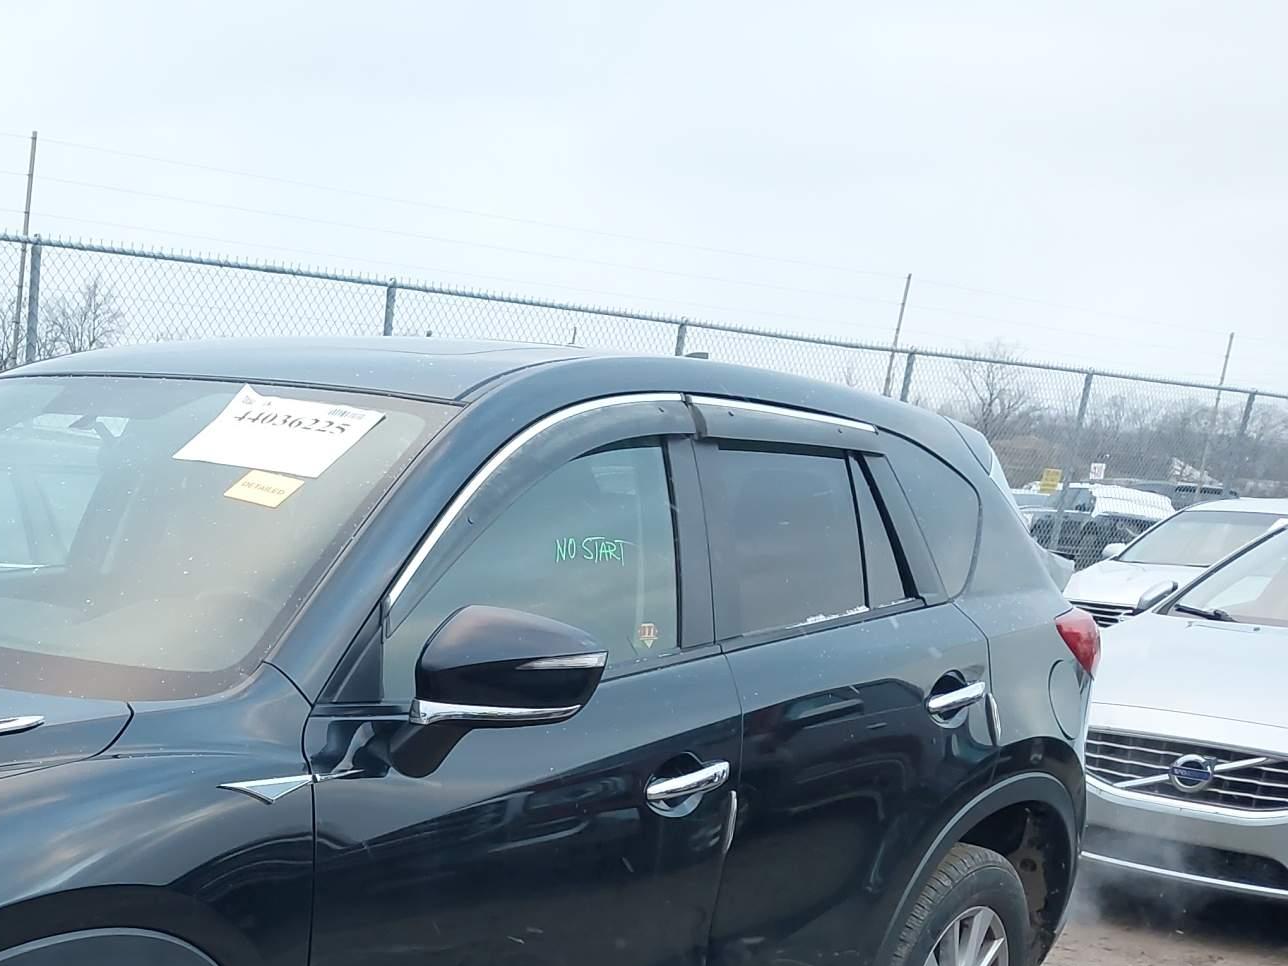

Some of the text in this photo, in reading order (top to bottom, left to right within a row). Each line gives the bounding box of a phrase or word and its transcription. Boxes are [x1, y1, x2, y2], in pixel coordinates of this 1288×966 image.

[234, 409, 352, 435] 44036225
[240, 480, 286, 496] DETAILED
[554, 535, 636, 567] NO START
